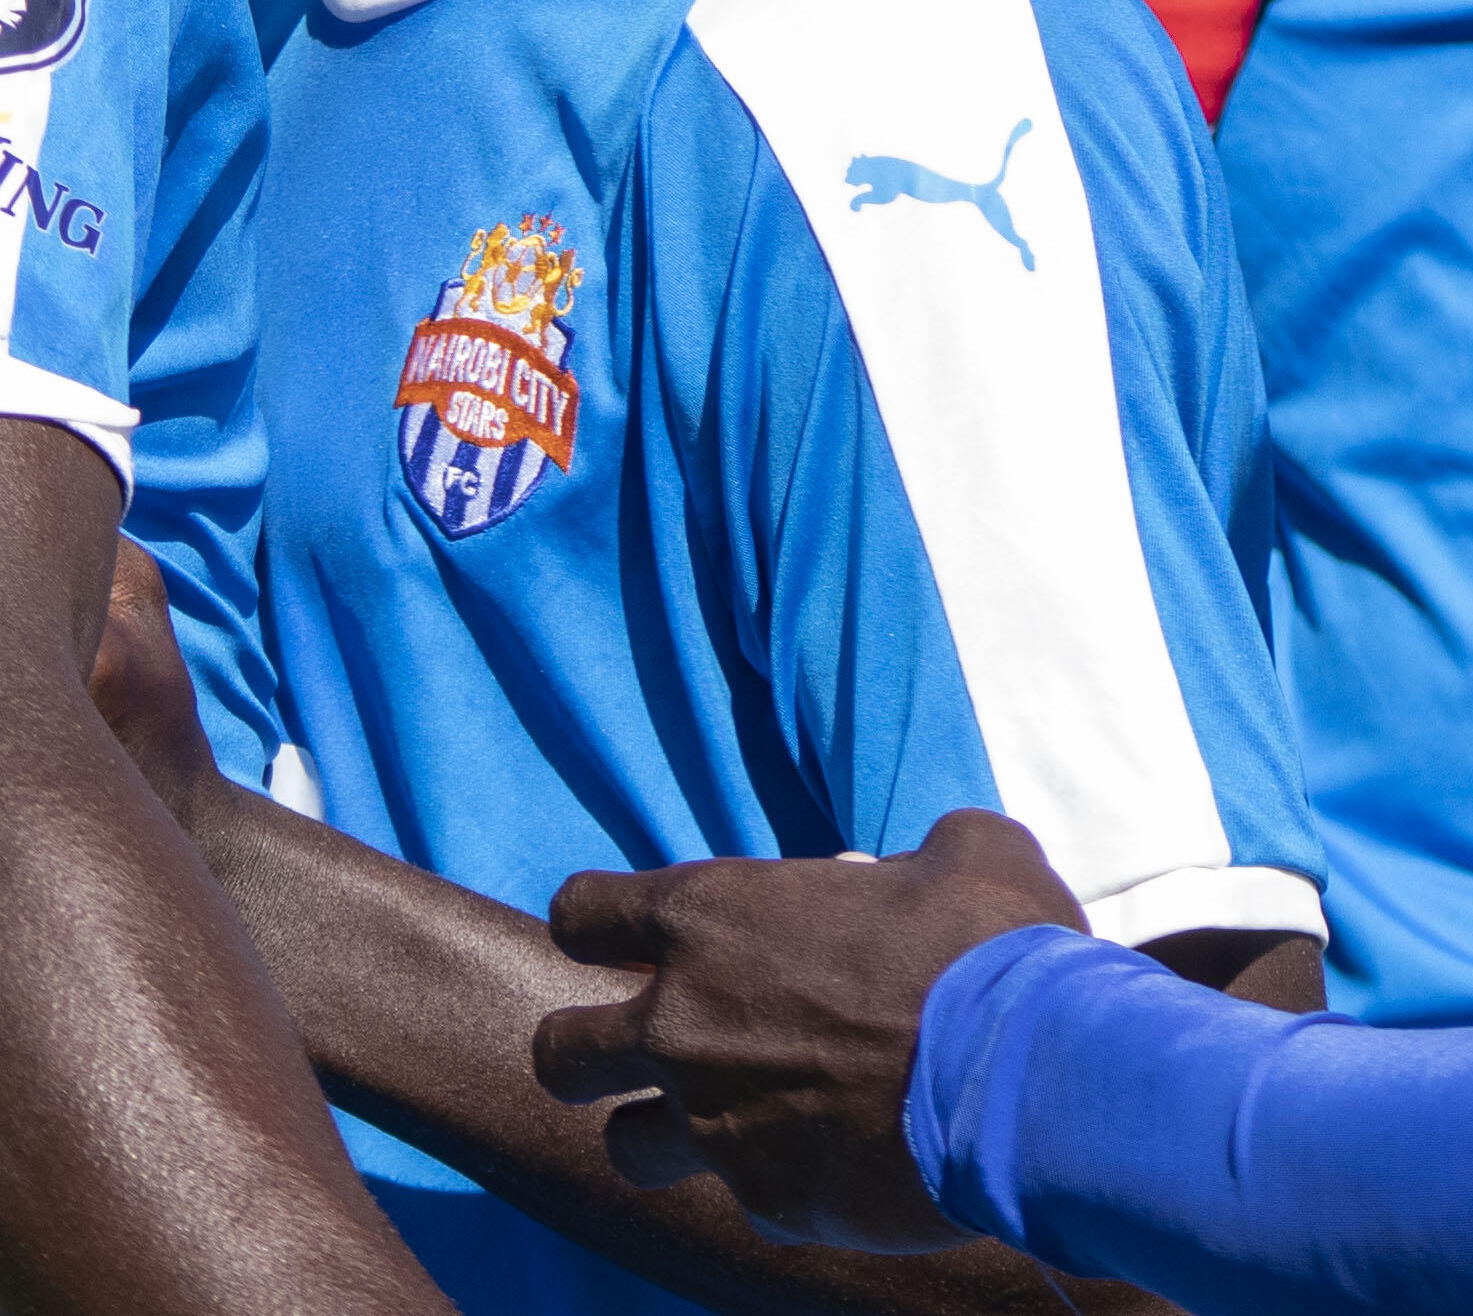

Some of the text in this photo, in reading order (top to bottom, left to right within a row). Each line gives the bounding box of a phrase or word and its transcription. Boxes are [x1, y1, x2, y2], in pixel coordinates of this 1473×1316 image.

[404, 333, 571, 437] NAIROBI CITY
[447, 390, 510, 441] STARS
[443, 462, 481, 497] FC
